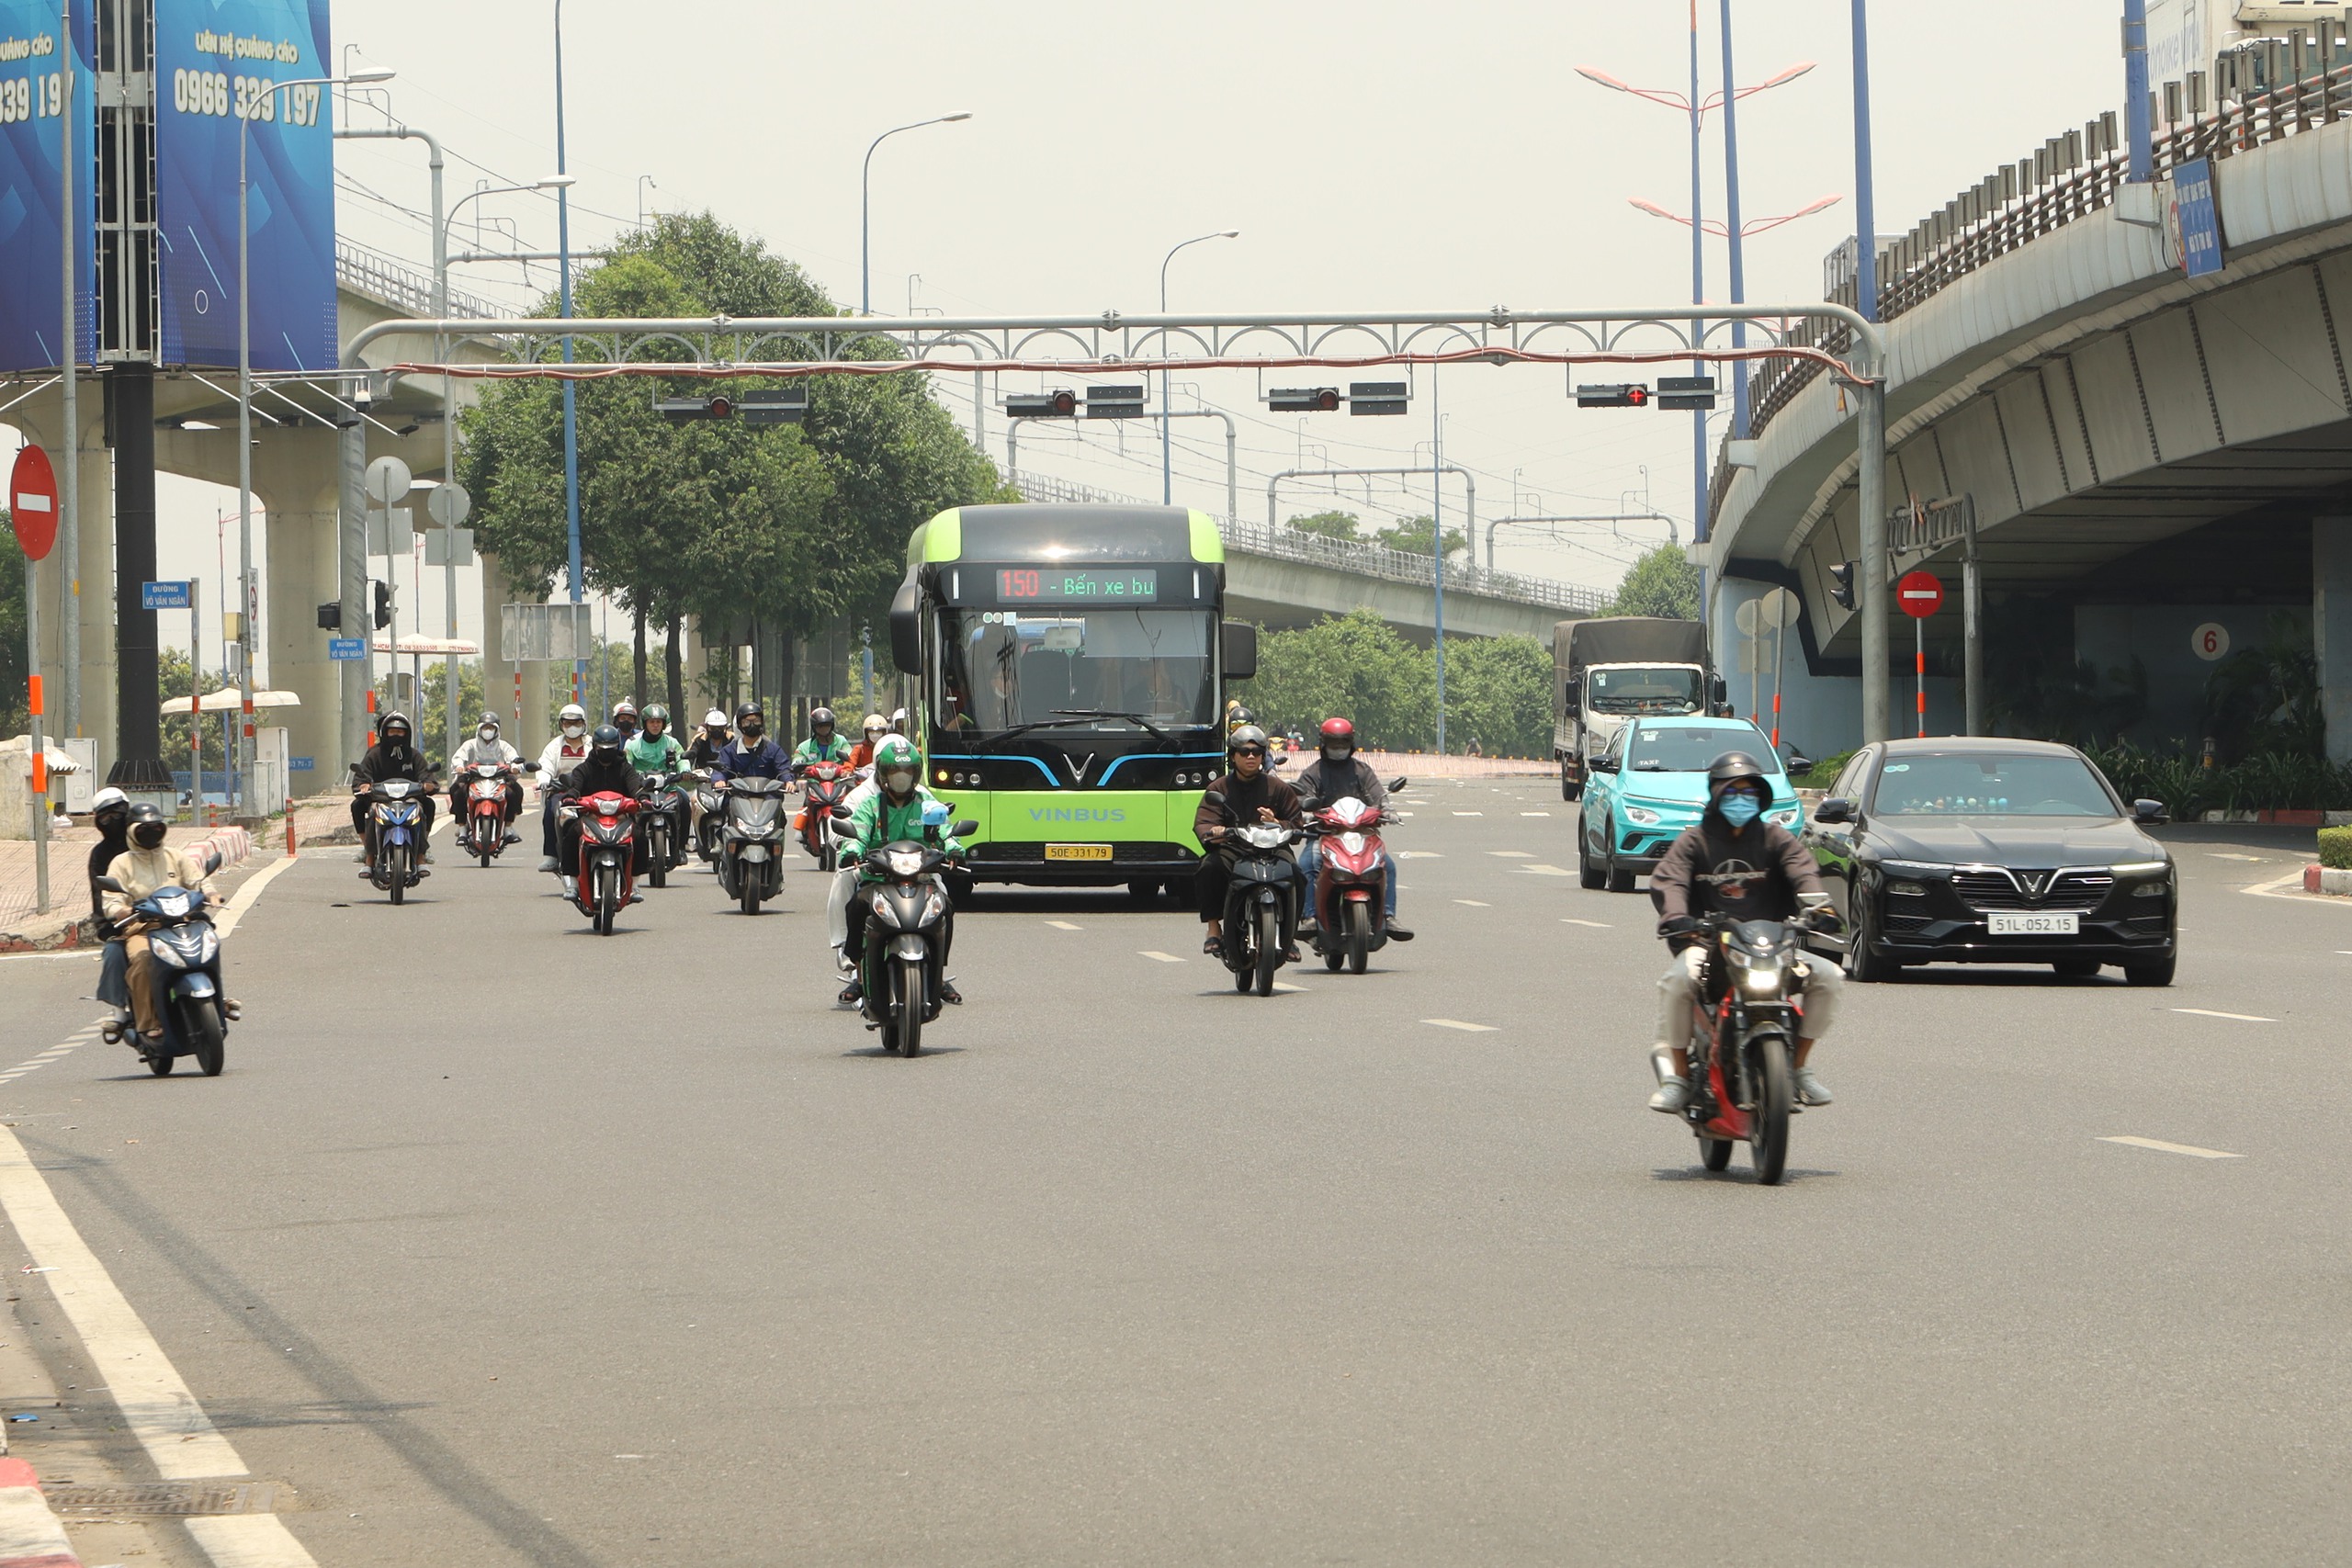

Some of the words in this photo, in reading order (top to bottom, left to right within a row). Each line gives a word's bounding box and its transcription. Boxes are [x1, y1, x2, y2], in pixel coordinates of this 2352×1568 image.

[0, 36, 29, 62] UẢNG
[31, 31, 53, 56] CÁO
[196, 28, 218, 53] LIÊN
[220, 31, 234, 61] HỆ
[235, 34, 276, 61] QUẢNG
[276, 39, 299, 63] CÁO
[175, 68, 228, 118] 0966
[234, 75, 276, 122] 339
[283, 84, 321, 127] 197
[153, 584, 178, 592] ĐƯỜNG
[1002, 570, 1039, 597] 150
[1064, 574, 1096, 595] Bến
[1104, 581, 1124, 595] xe
[1132, 577, 1154, 595] bu
[2204, 630, 2217, 653] 6
[908, 818, 924, 827] Gra
[1029, 807, 1125, 822] VINBUS
[1050, 848, 1107, 858] 50E-331.79
[1996, 919, 2071, 931] 51L-052.15
